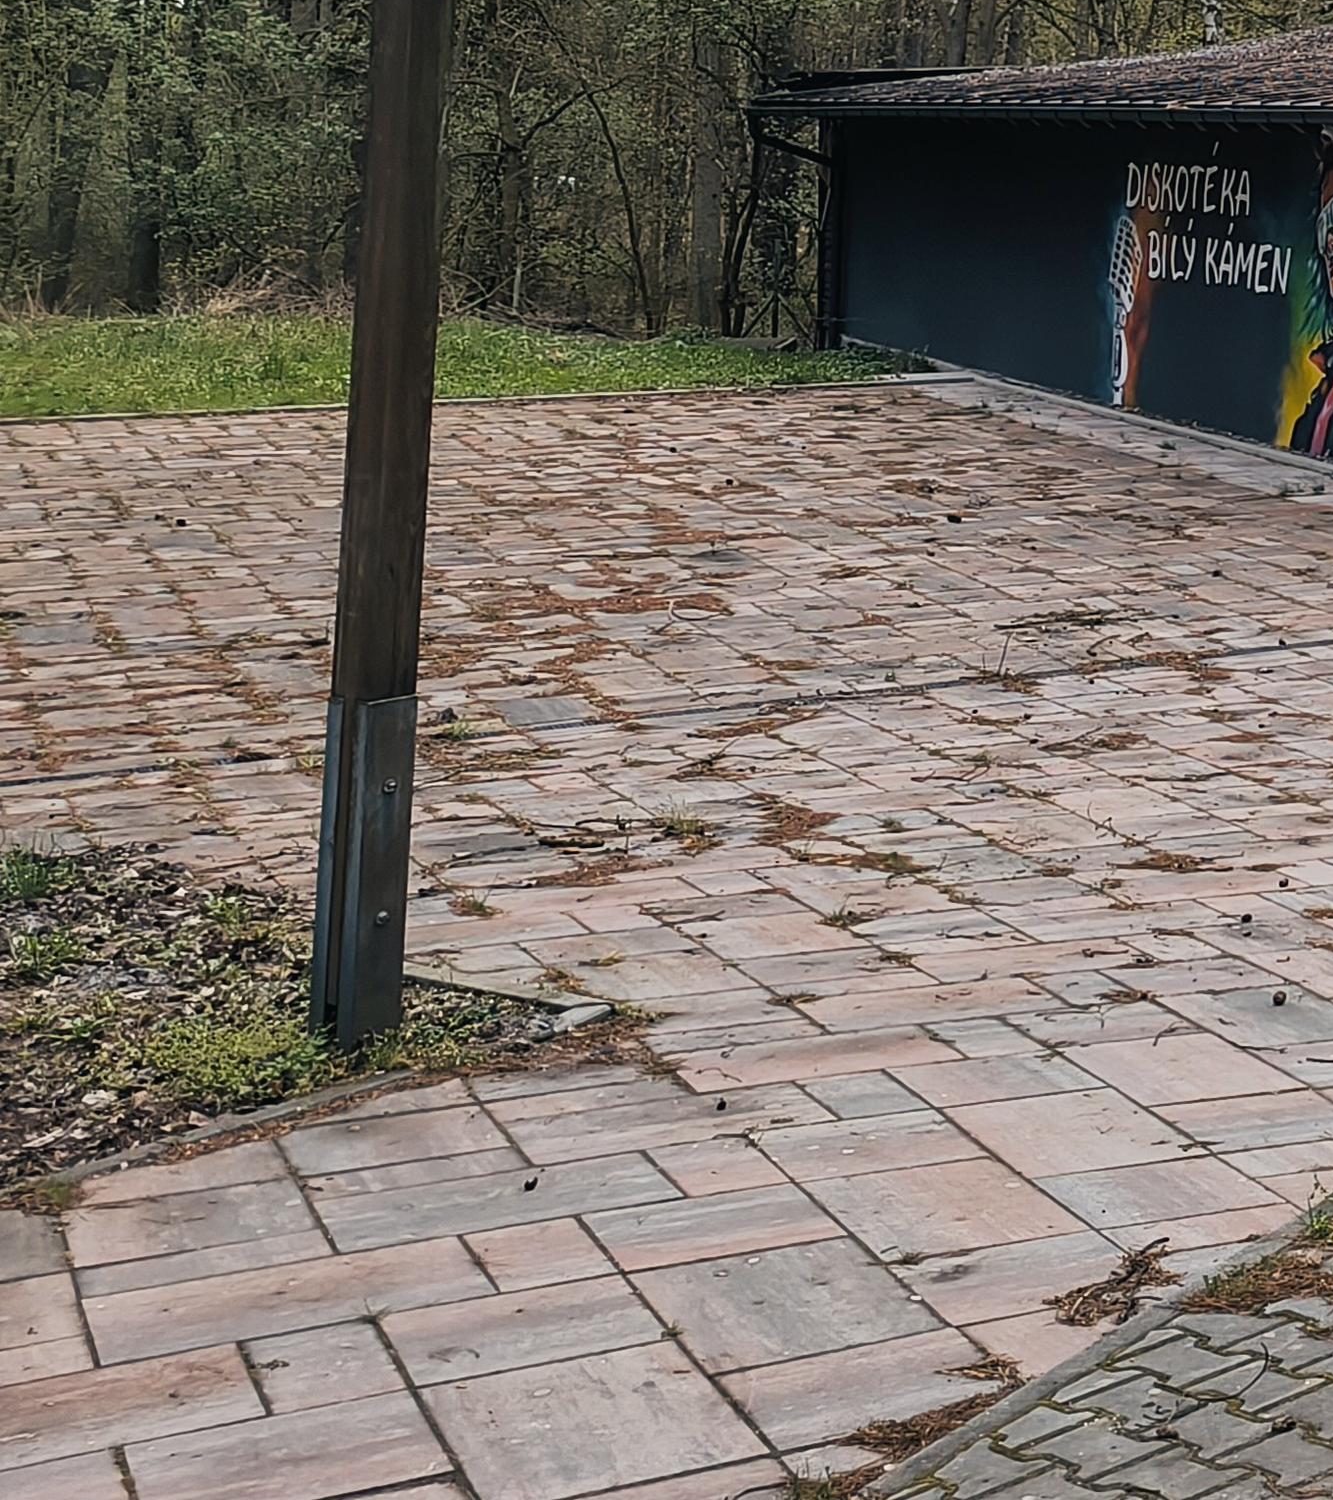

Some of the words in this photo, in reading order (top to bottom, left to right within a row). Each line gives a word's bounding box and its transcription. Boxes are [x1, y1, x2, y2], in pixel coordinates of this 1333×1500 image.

[1125, 141, 1251, 217] DISKOTÉKA
[1148, 216, 1197, 282] BÍLÝ
[1204, 222, 1292, 295] KÁMEN
